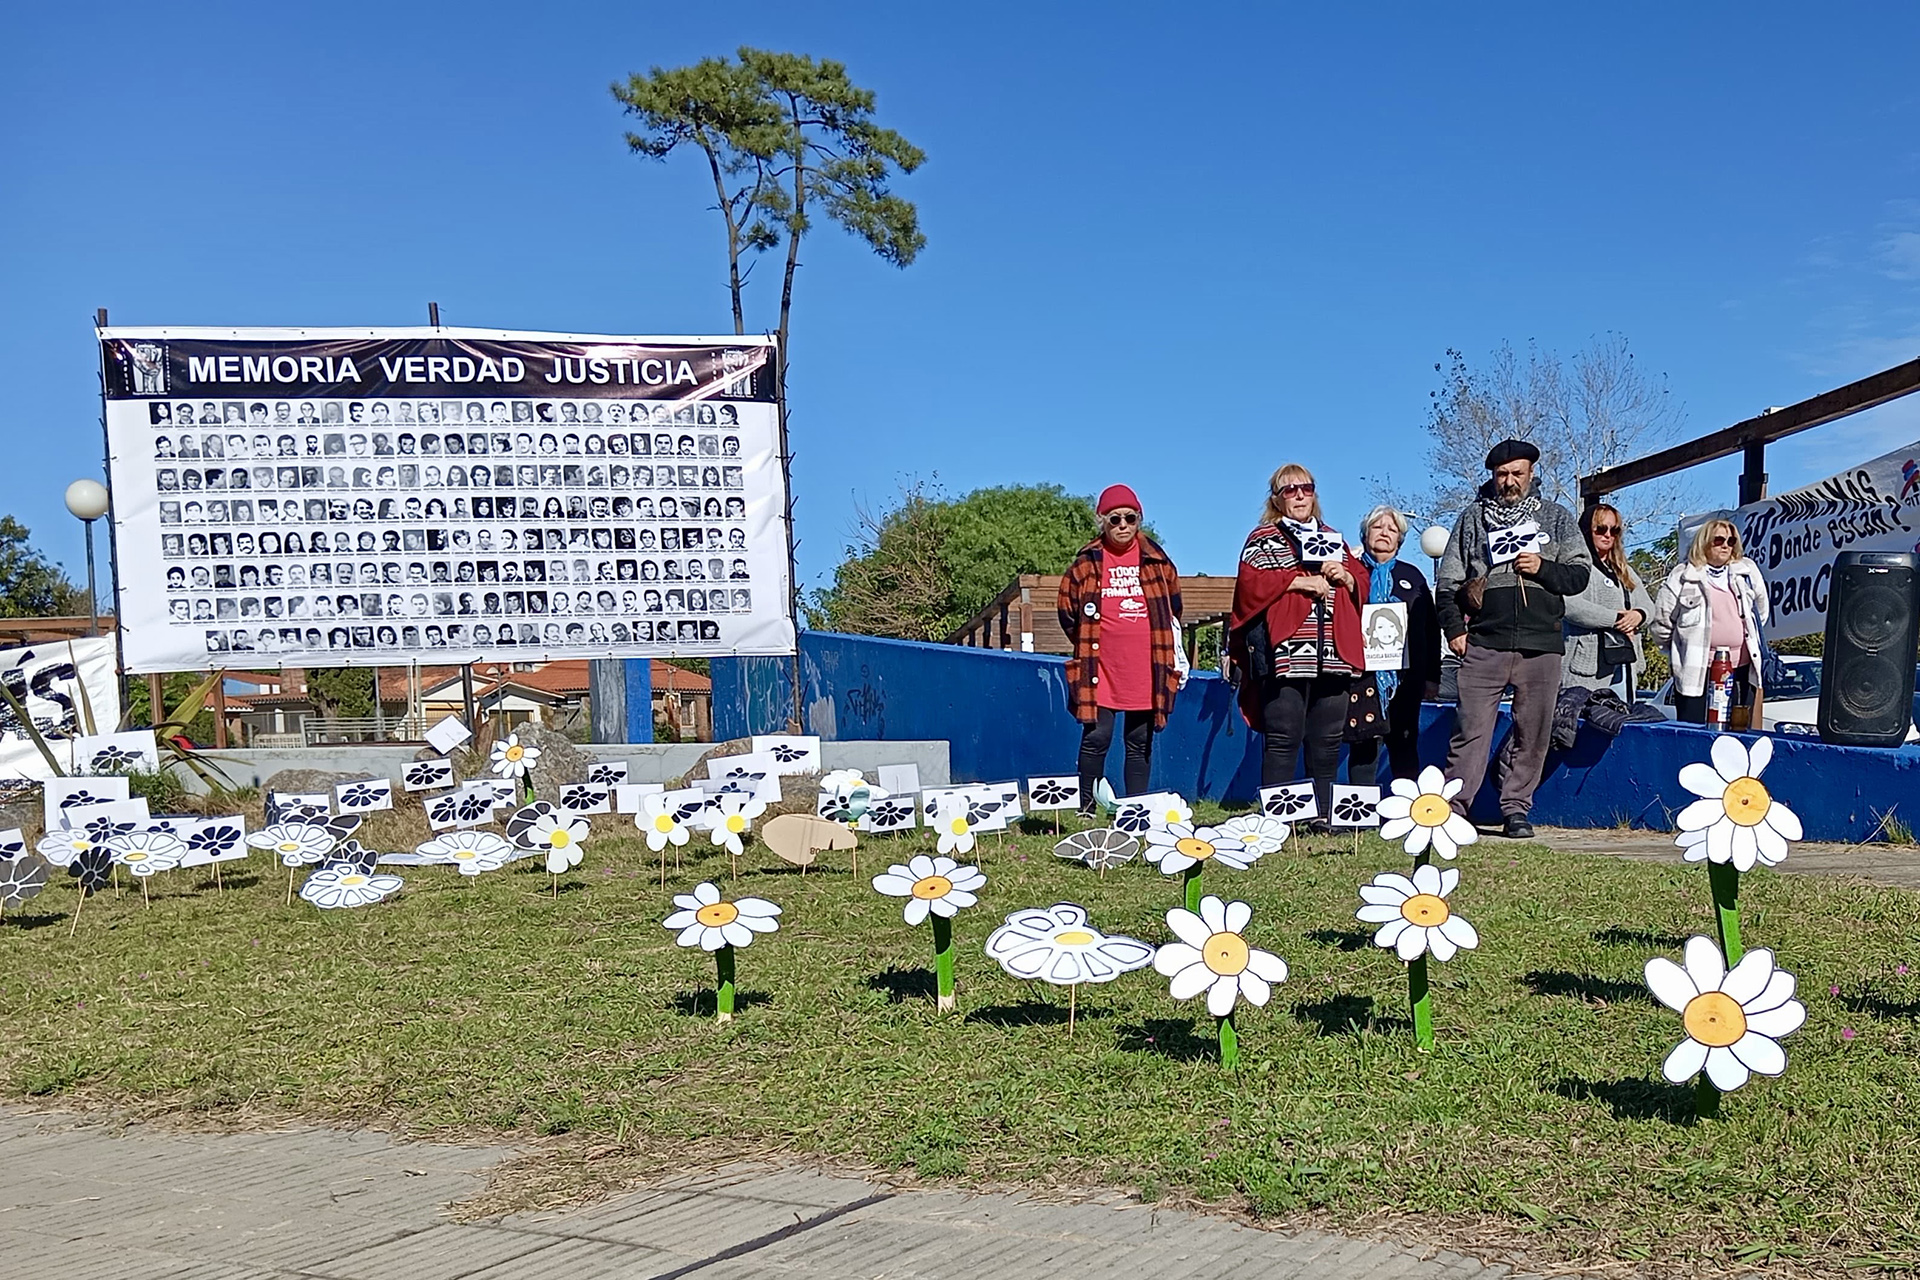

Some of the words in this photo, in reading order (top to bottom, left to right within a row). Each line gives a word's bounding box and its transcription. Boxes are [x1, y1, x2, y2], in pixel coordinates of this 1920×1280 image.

[188, 355, 362, 384] MEMORIA
[379, 355, 526, 385] VERDAD
[545, 356, 699, 386] JUSTICIA
[1768, 523, 1820, 570] Dónde
[1109, 576, 1141, 588] SOMO
